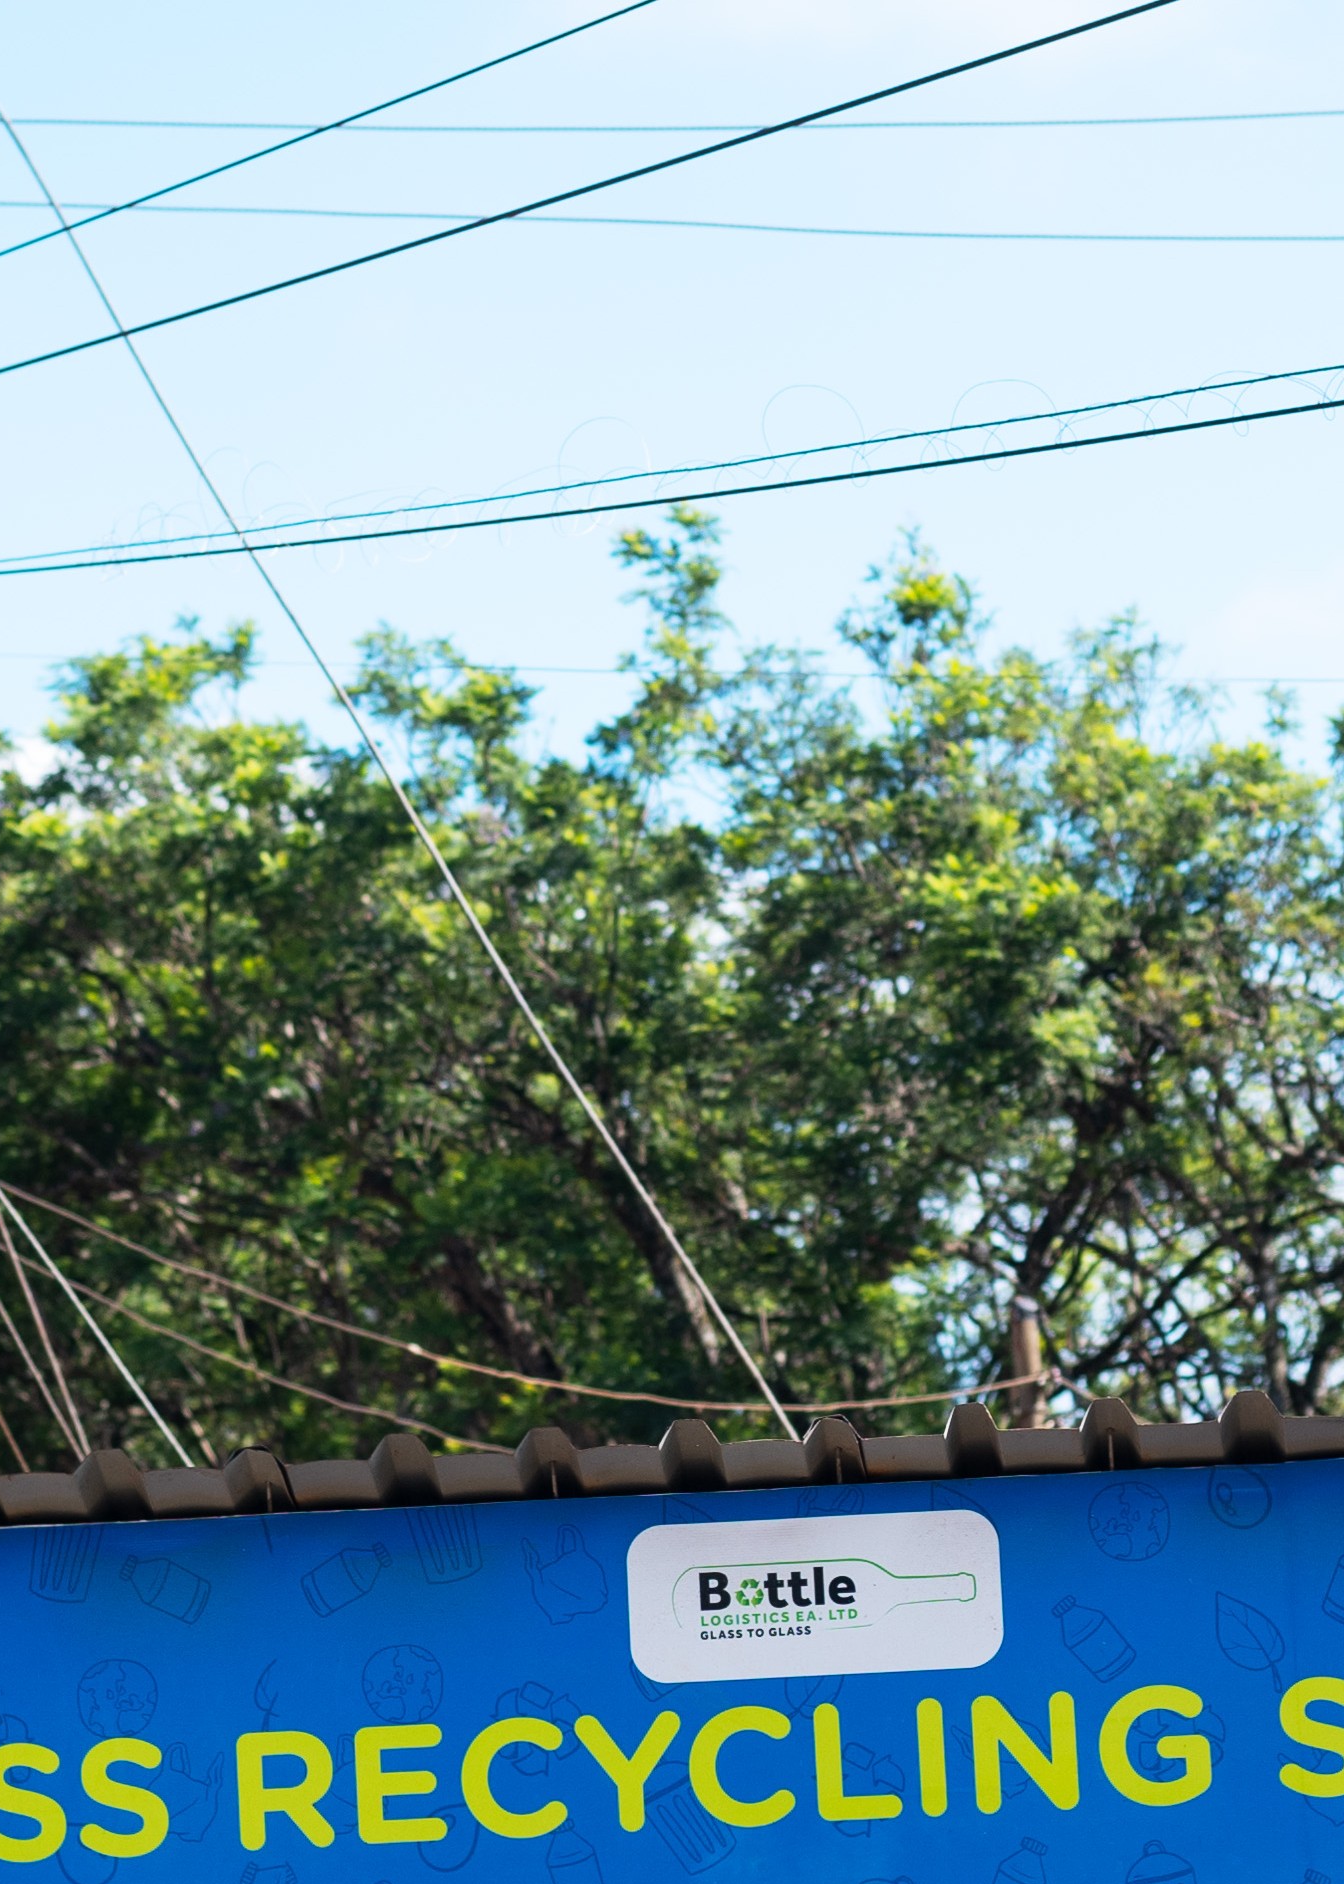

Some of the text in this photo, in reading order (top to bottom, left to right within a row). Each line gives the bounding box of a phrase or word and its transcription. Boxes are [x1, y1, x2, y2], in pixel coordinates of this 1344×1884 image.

[701, 1609, 858, 1626] LOGISTICS EA. LTD
[700, 1626, 811, 1640] GLASS TO GLASS
[237, 1684, 1214, 1852] RECYCLING
